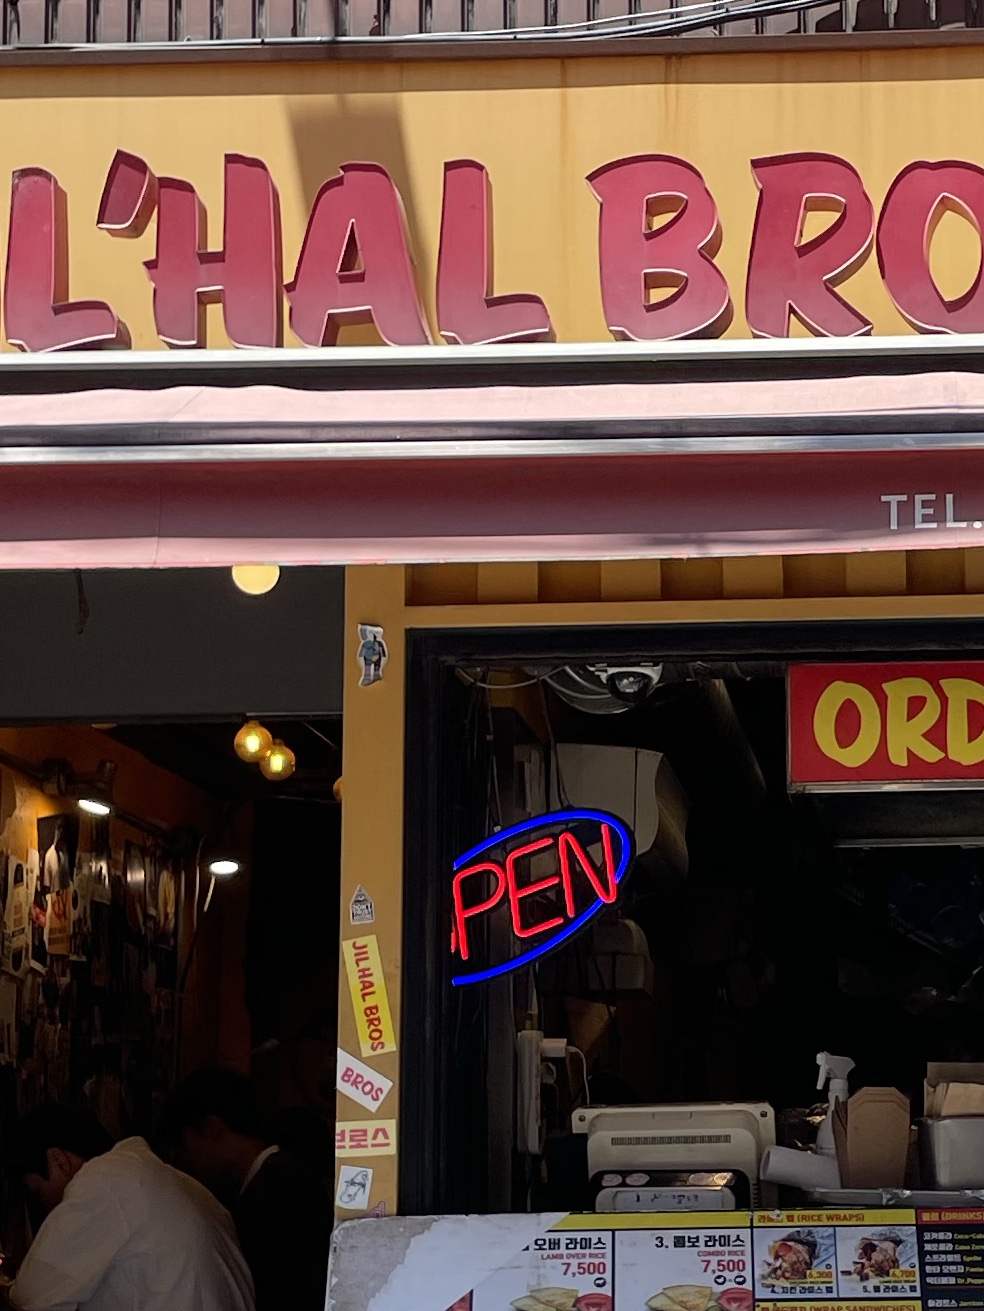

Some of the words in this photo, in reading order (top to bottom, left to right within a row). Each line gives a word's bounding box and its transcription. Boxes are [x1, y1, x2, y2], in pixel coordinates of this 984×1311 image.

[451, 823, 618, 960] PEN
[352, 941, 376, 1003] JILHAL
[363, 1004, 385, 1052] BROS
[340, 1066, 384, 1102] BROS
[797, 1213, 824, 1223] (RICE
[826, 1213, 865, 1222] WRAPS)
[565, 1236, 607, 1250] 라이스
[655, 1236, 669, 1248] 3.
[704, 1234, 745, 1247] 라이스
[561, 1262, 606, 1277] 7,500
[701, 1259, 746, 1275] 7,500
